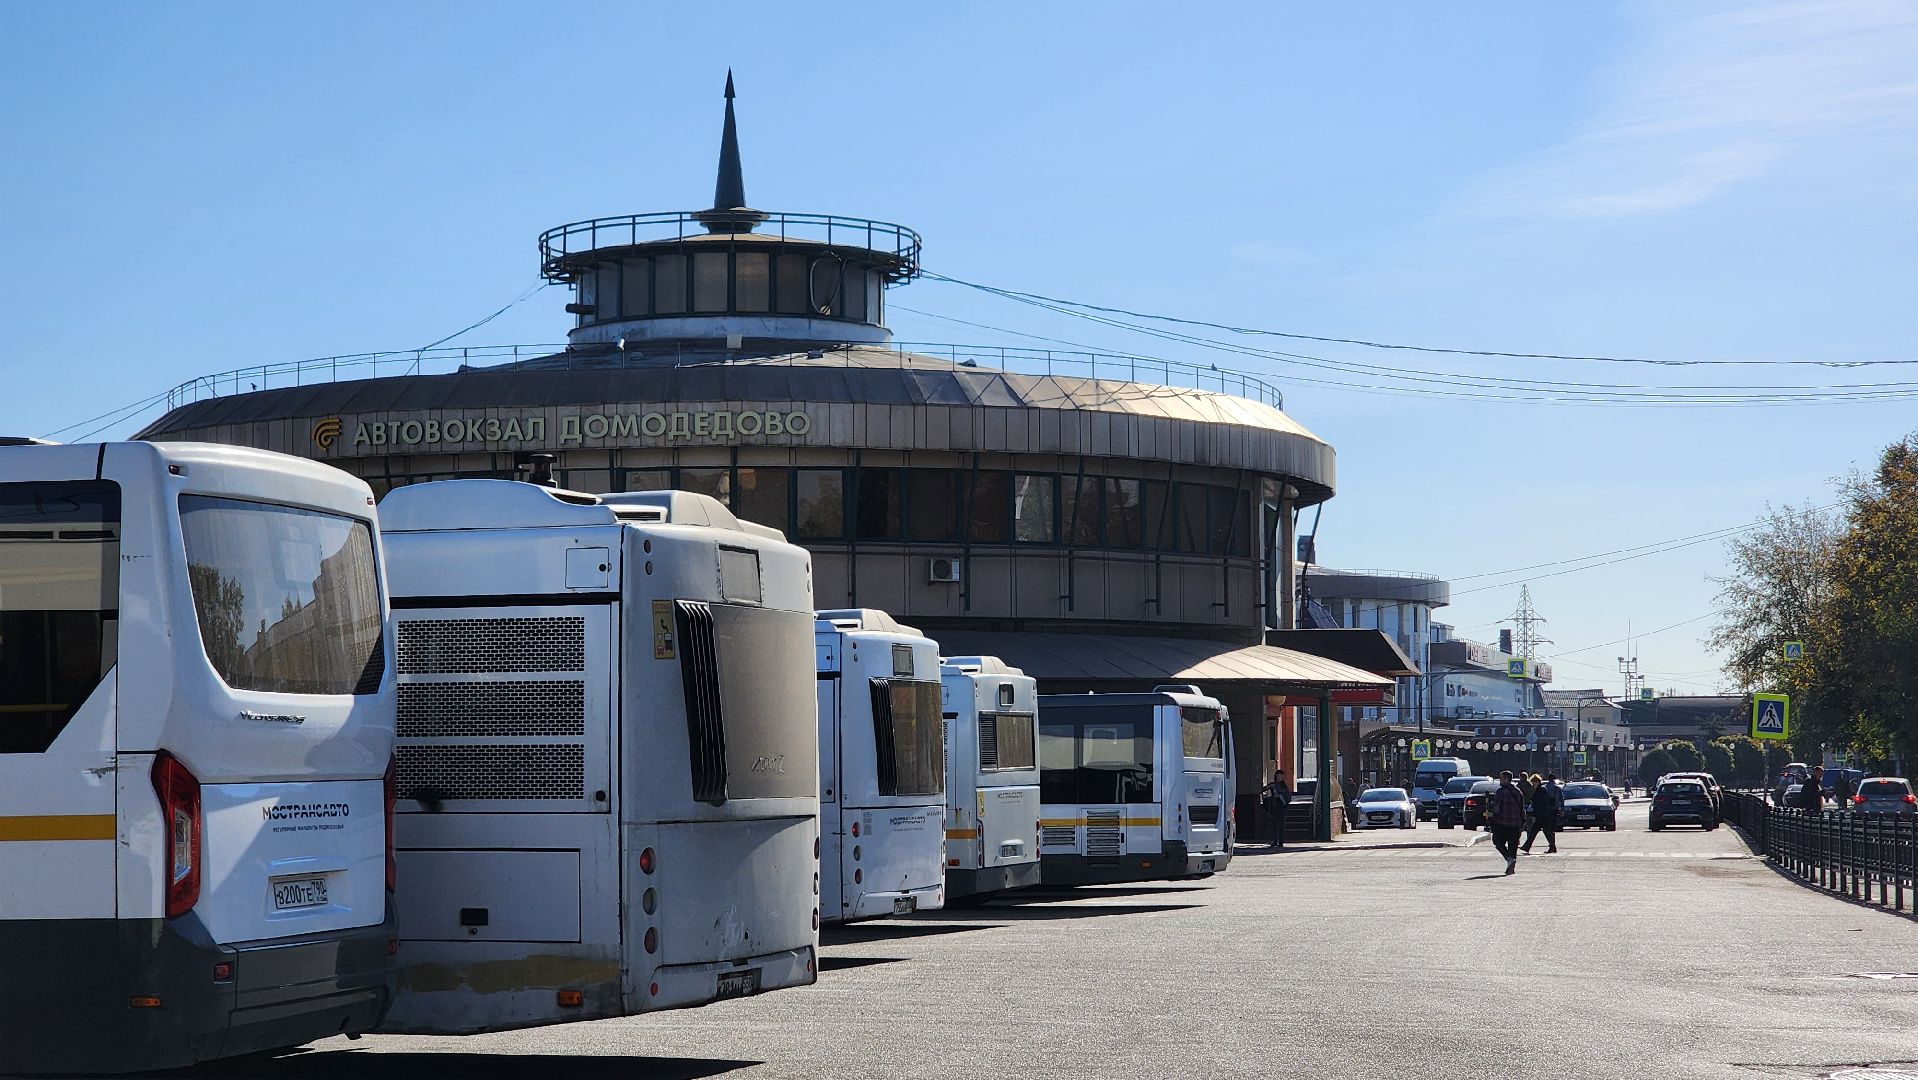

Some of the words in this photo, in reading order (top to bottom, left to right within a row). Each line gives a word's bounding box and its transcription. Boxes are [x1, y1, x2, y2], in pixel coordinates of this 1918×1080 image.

[352, 416, 546, 446] АВТОВОКЗАЛ
[559, 410, 812, 444] ДОМОДЕДОВО
[262, 803, 350, 821] МОСТРАНСАВТО
